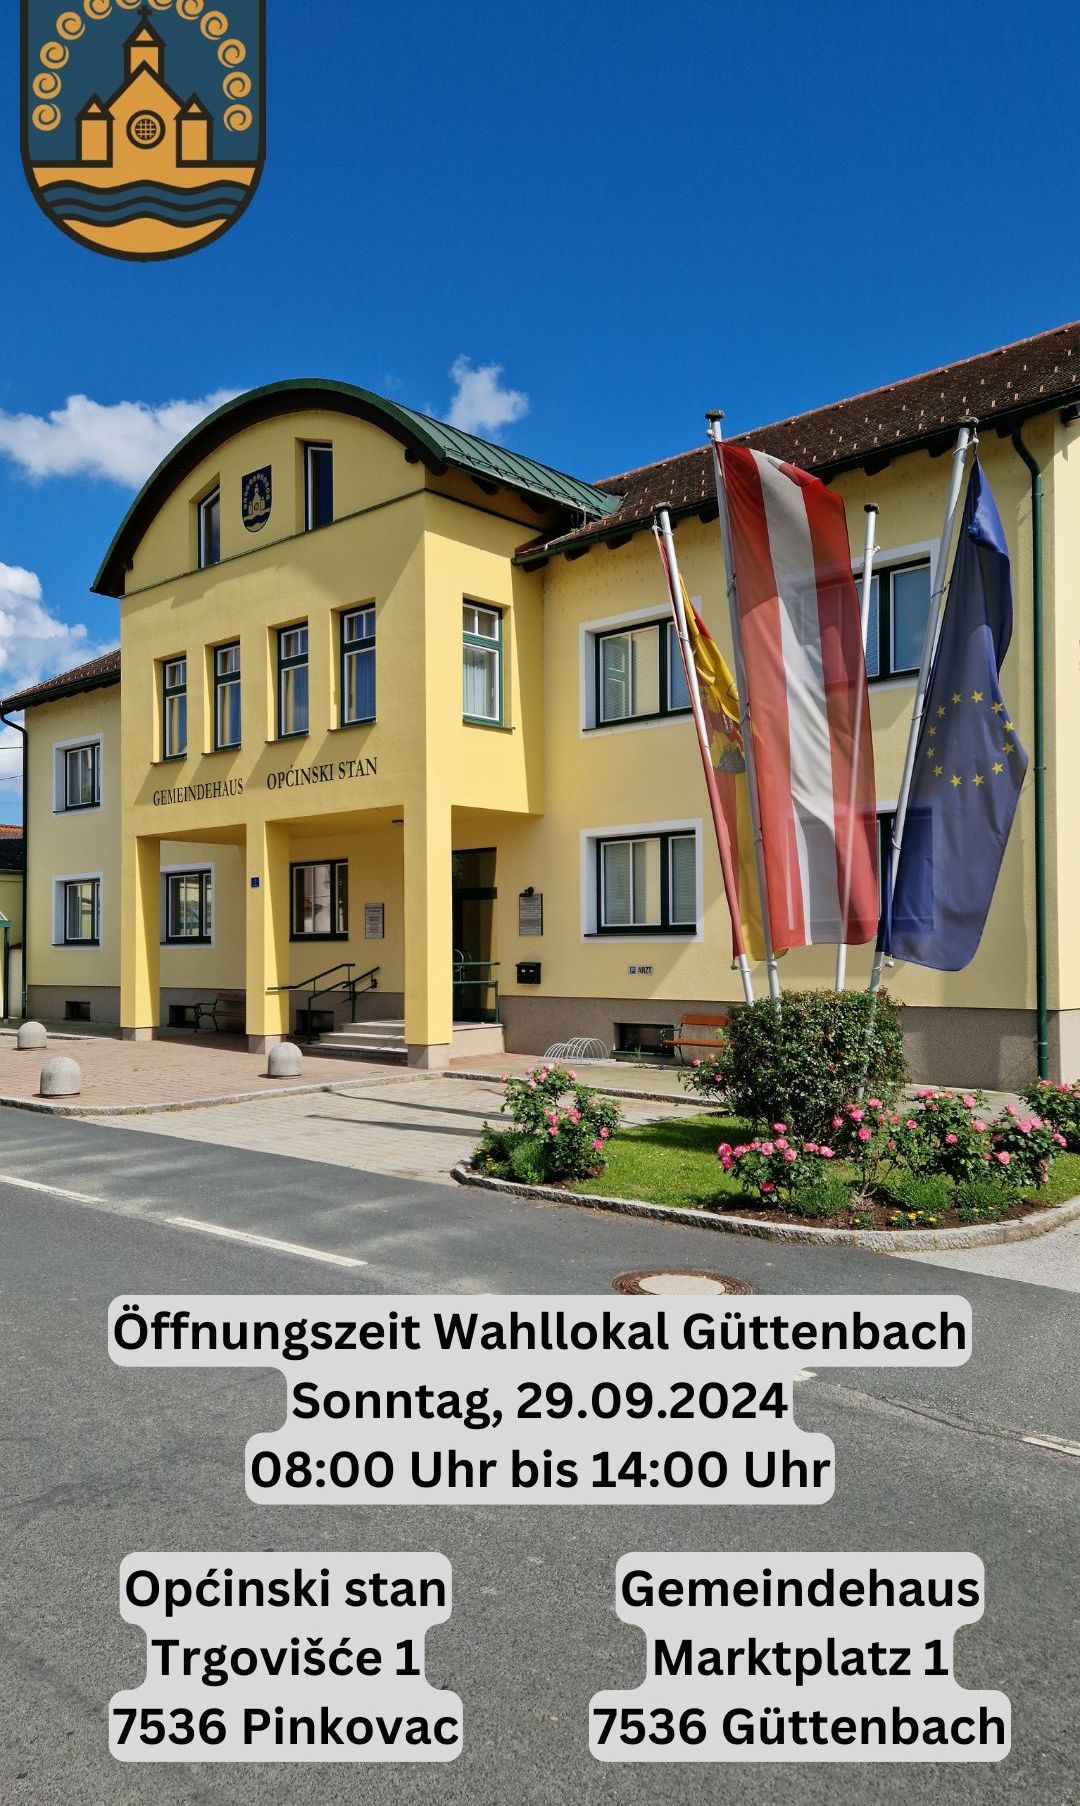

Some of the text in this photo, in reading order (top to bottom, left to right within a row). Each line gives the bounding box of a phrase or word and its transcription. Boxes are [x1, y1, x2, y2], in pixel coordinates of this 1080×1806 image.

[267, 757, 377, 789] OPĆINSKI STAN
[153, 778, 244, 806] GEMEINDEHAUS
[637, 966, 652, 974] ARZT
